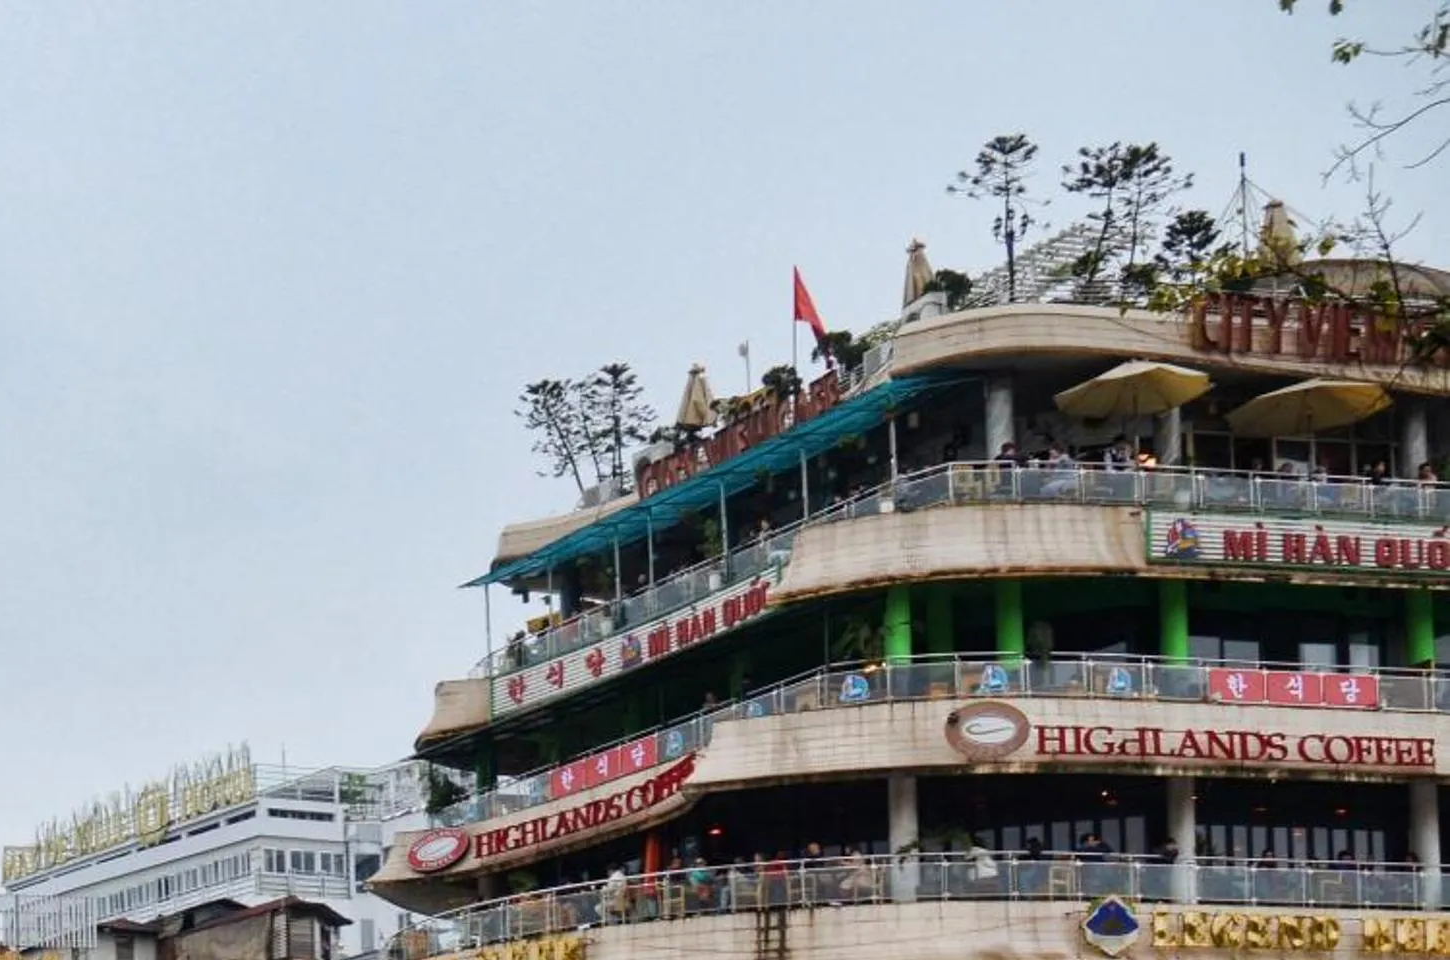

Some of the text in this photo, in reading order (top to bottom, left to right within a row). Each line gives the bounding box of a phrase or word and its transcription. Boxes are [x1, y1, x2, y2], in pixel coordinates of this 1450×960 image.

[1223, 522, 1268, 561] MÌ
[1283, 524, 1361, 566] HÀN
[1298, 733, 1437, 768] COFFEE
[474, 799, 624, 859] HIGHLANDS
